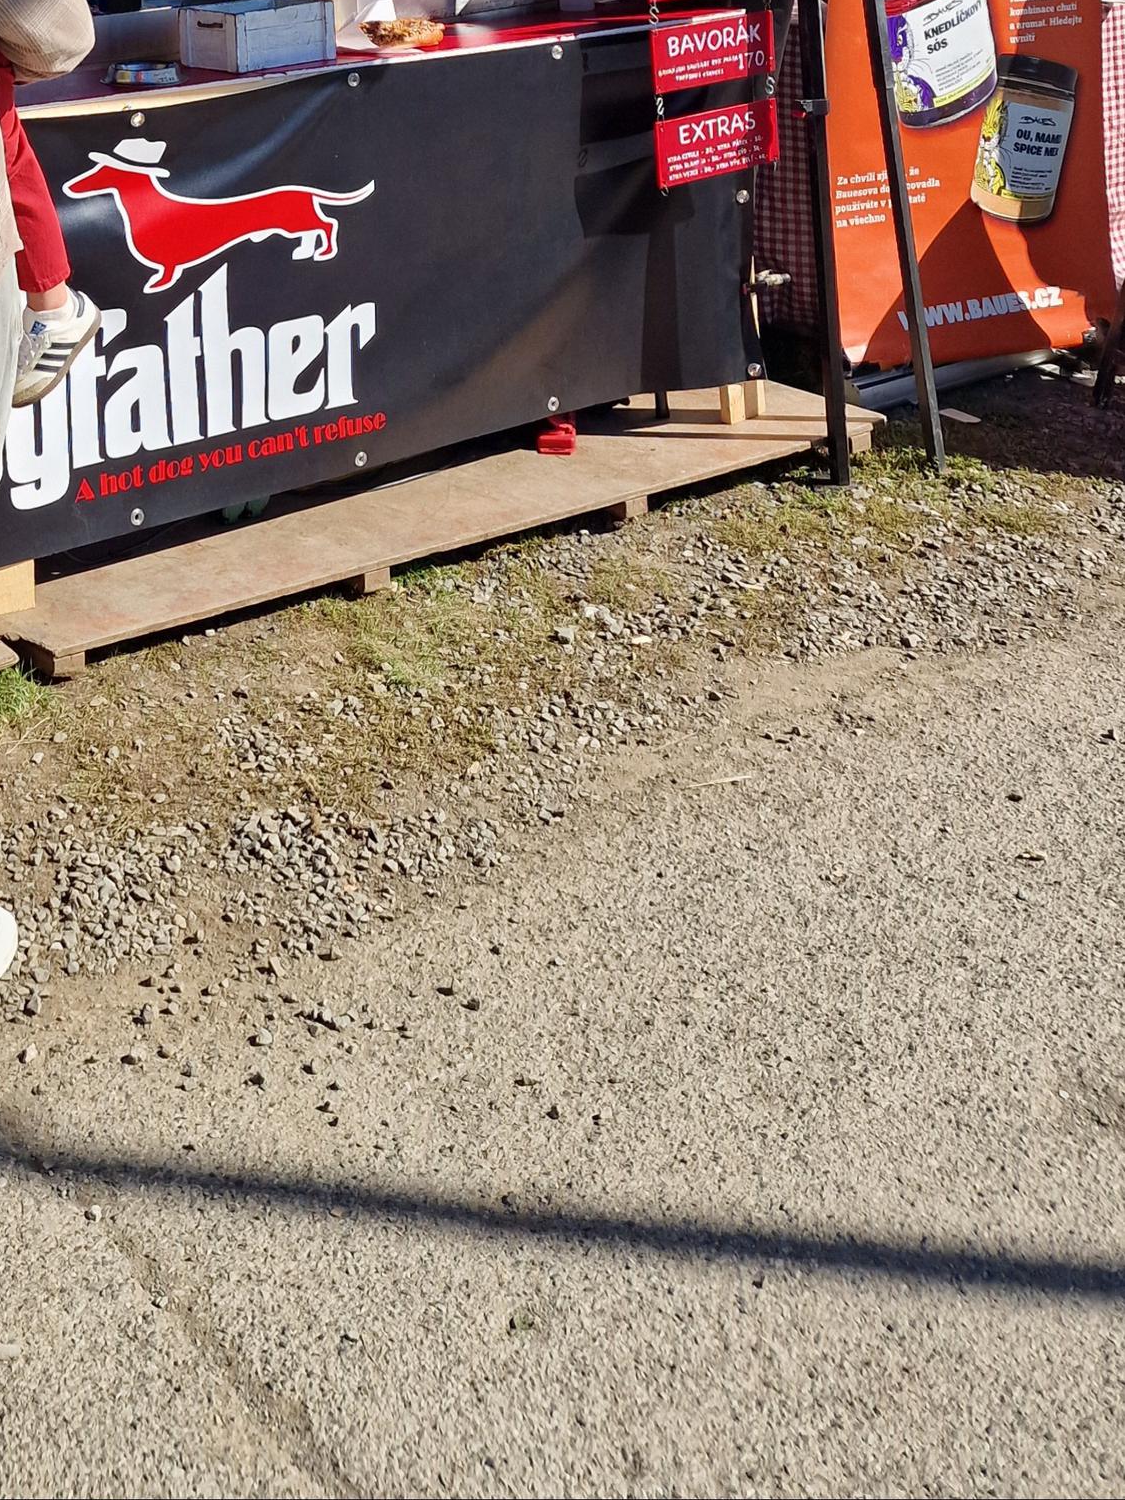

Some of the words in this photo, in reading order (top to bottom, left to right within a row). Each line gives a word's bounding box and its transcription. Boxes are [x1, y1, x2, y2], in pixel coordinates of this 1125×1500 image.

[1050, 16, 1082, 27] Hledejte
[667, 19, 761, 57] BAVORÁK
[927, 39, 948, 54] SÓS
[679, 111, 755, 144] EXTRAS
[1017, 129, 1032, 142] OU,
[1013, 142, 1042, 156] SPICE
[837, 176, 848, 185] Za
[836, 187, 878, 199] Bauesova
[836, 220, 850, 228] na
[75, 477, 95, 503] A
[99, 469, 143, 497] hot
[149, 454, 193, 483] dog
[198, 441, 243, 472] you
[247, 425, 309, 460] can't
[314, 411, 386, 443] refuse
